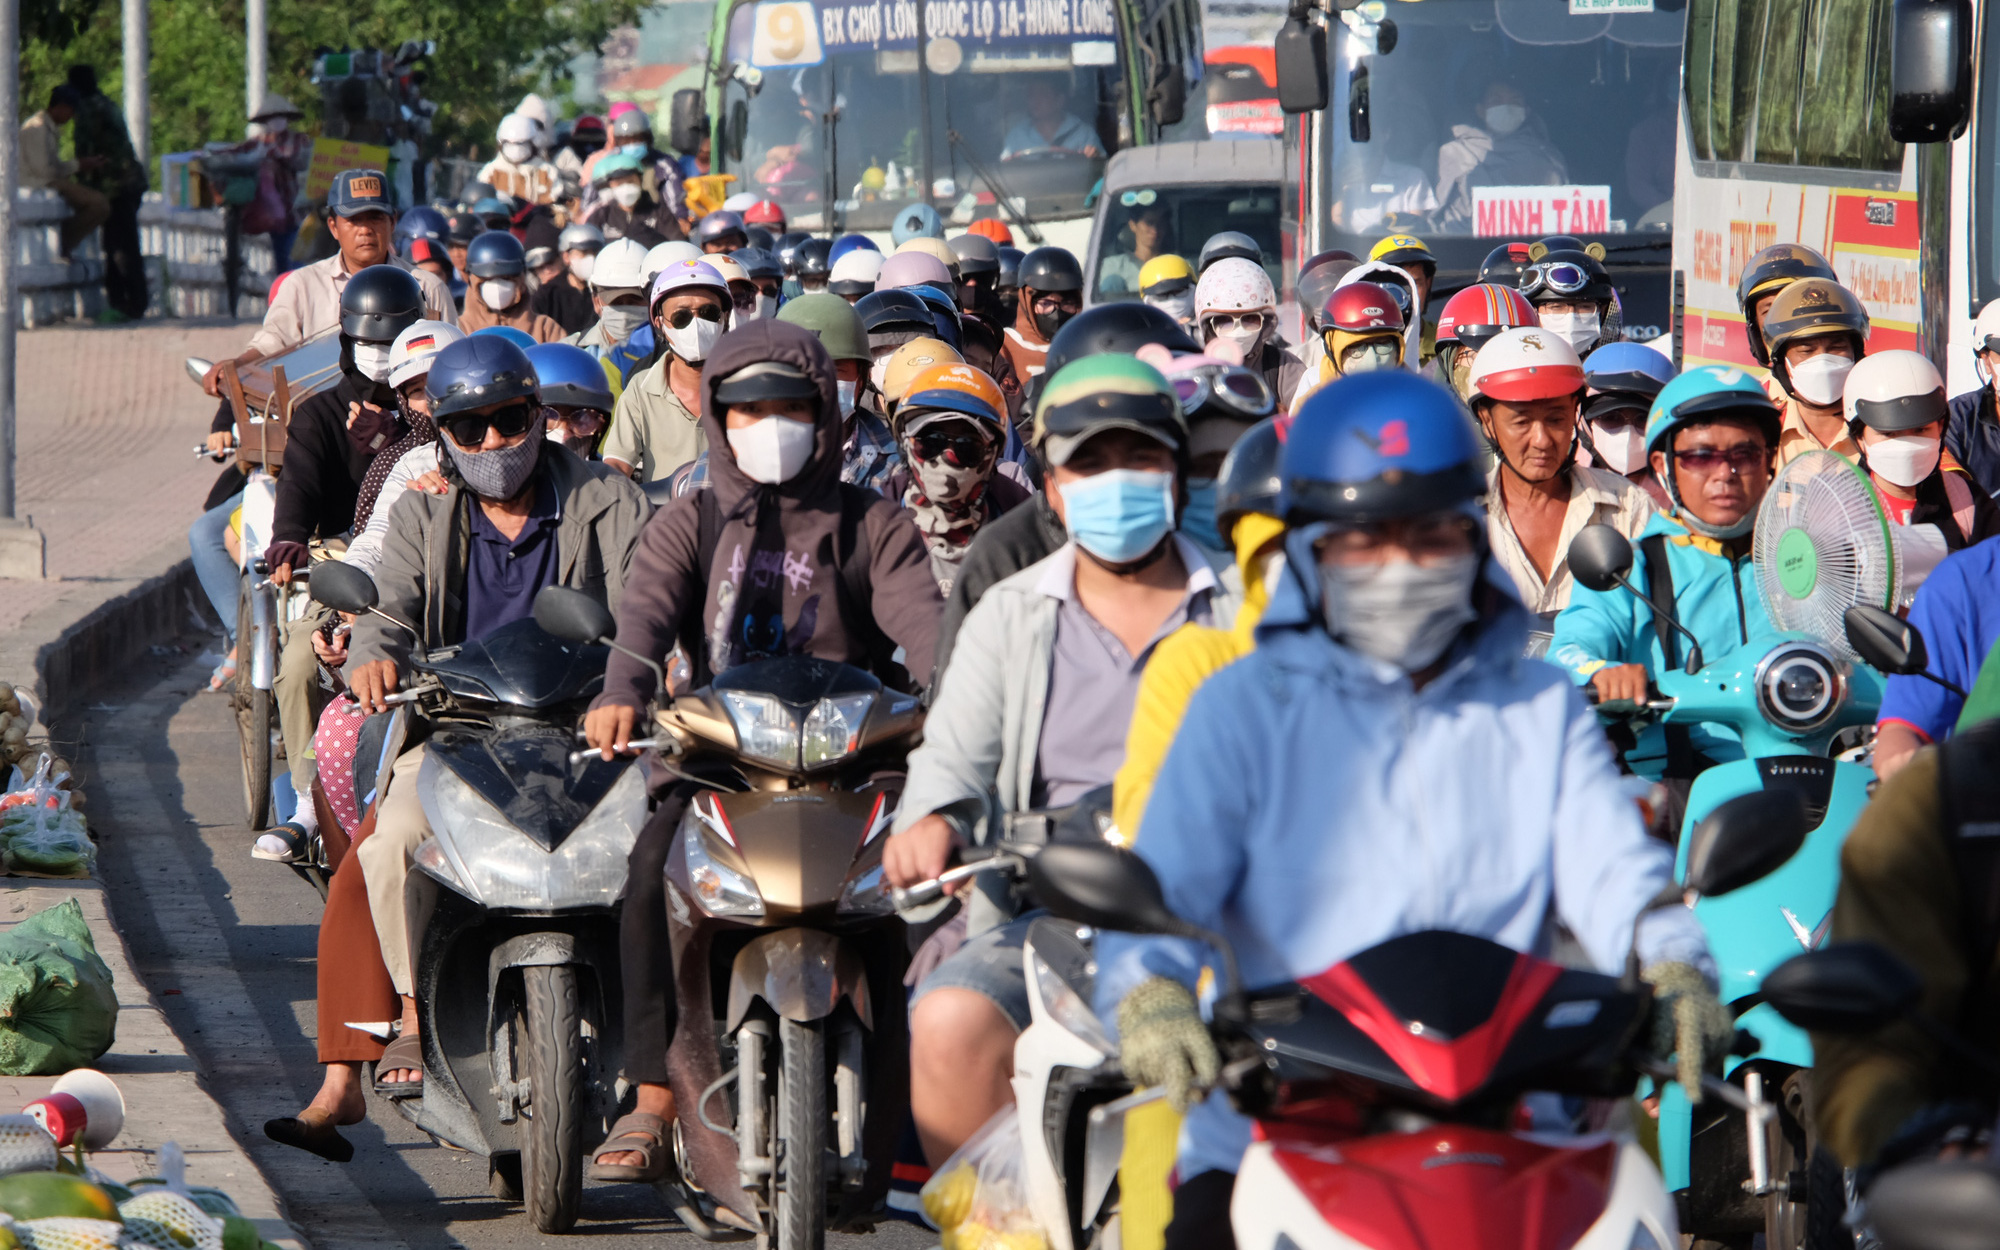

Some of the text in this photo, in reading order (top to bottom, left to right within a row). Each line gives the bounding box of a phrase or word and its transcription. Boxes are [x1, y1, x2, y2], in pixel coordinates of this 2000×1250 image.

[768, 4, 806, 60] 9
[823, 8, 847, 46] BX
[848, 0, 881, 50] CHỢ
[1072, 0, 1114, 36] LONG
[352, 178, 379, 192] LEVI'S
[1477, 189, 1608, 237] MINH TÂM
[937, 375, 981, 390] AhaMove
[1770, 765, 1825, 776] VINFAST
